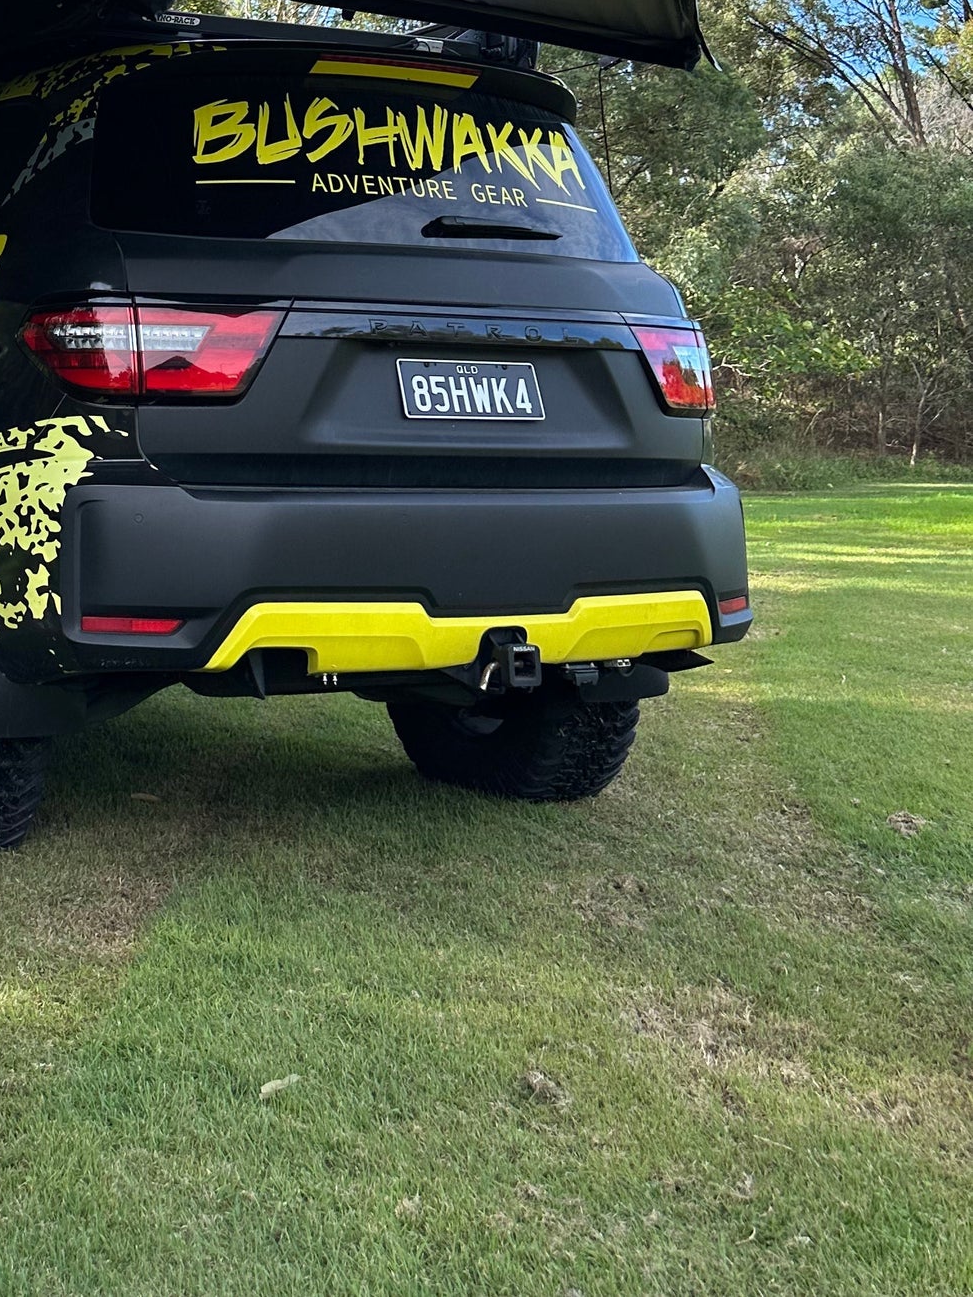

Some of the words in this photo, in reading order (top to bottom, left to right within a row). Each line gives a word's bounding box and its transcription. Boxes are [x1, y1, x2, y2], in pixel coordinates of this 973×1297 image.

[192, 93, 587, 194] BUSHWAKKA
[312, 173, 457, 200] ADVENTURE
[471, 183, 528, 207] GEAR
[368, 319, 579, 343] PATROL
[456, 365, 478, 374] QLD
[411, 375, 532, 413] 85HWK4
